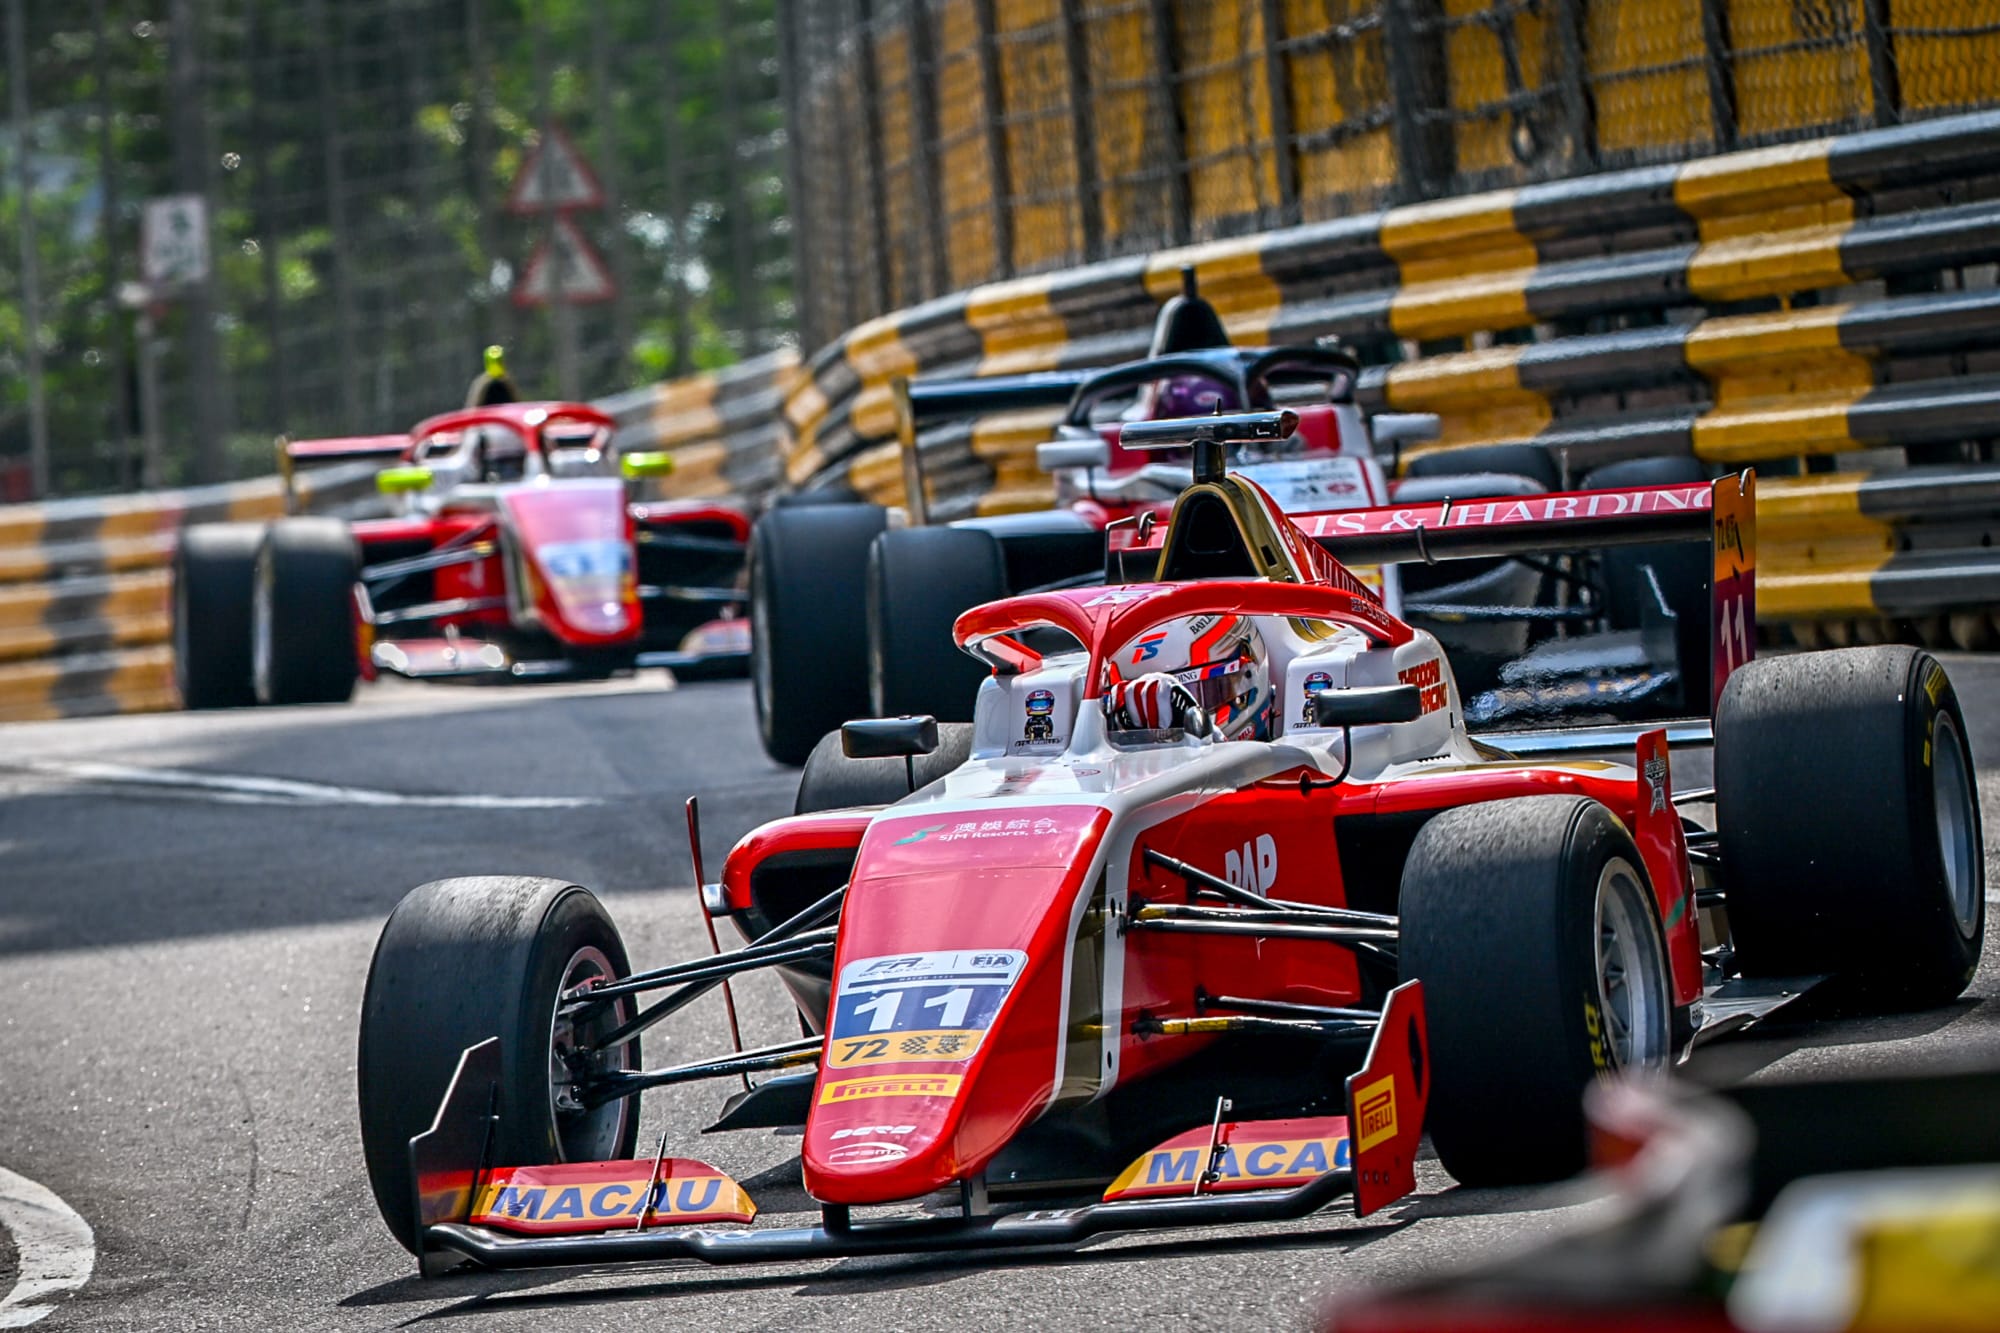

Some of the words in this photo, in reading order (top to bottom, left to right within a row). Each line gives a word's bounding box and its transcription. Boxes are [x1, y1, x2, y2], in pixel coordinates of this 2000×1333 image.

[1380, 509, 1427, 532] &
[1720, 594, 1748, 672] 11
[1174, 671, 1198, 685] DING
[938, 833, 968, 842] SJM
[973, 956, 1009, 968] FIA
[854, 988, 974, 1032] 11
[840, 1038, 890, 1062] 72
[832, 1078, 948, 1099] PIRELLI
[1360, 1089, 1393, 1139] PIRELLI
[490, 1179, 723, 1221] MACAU
